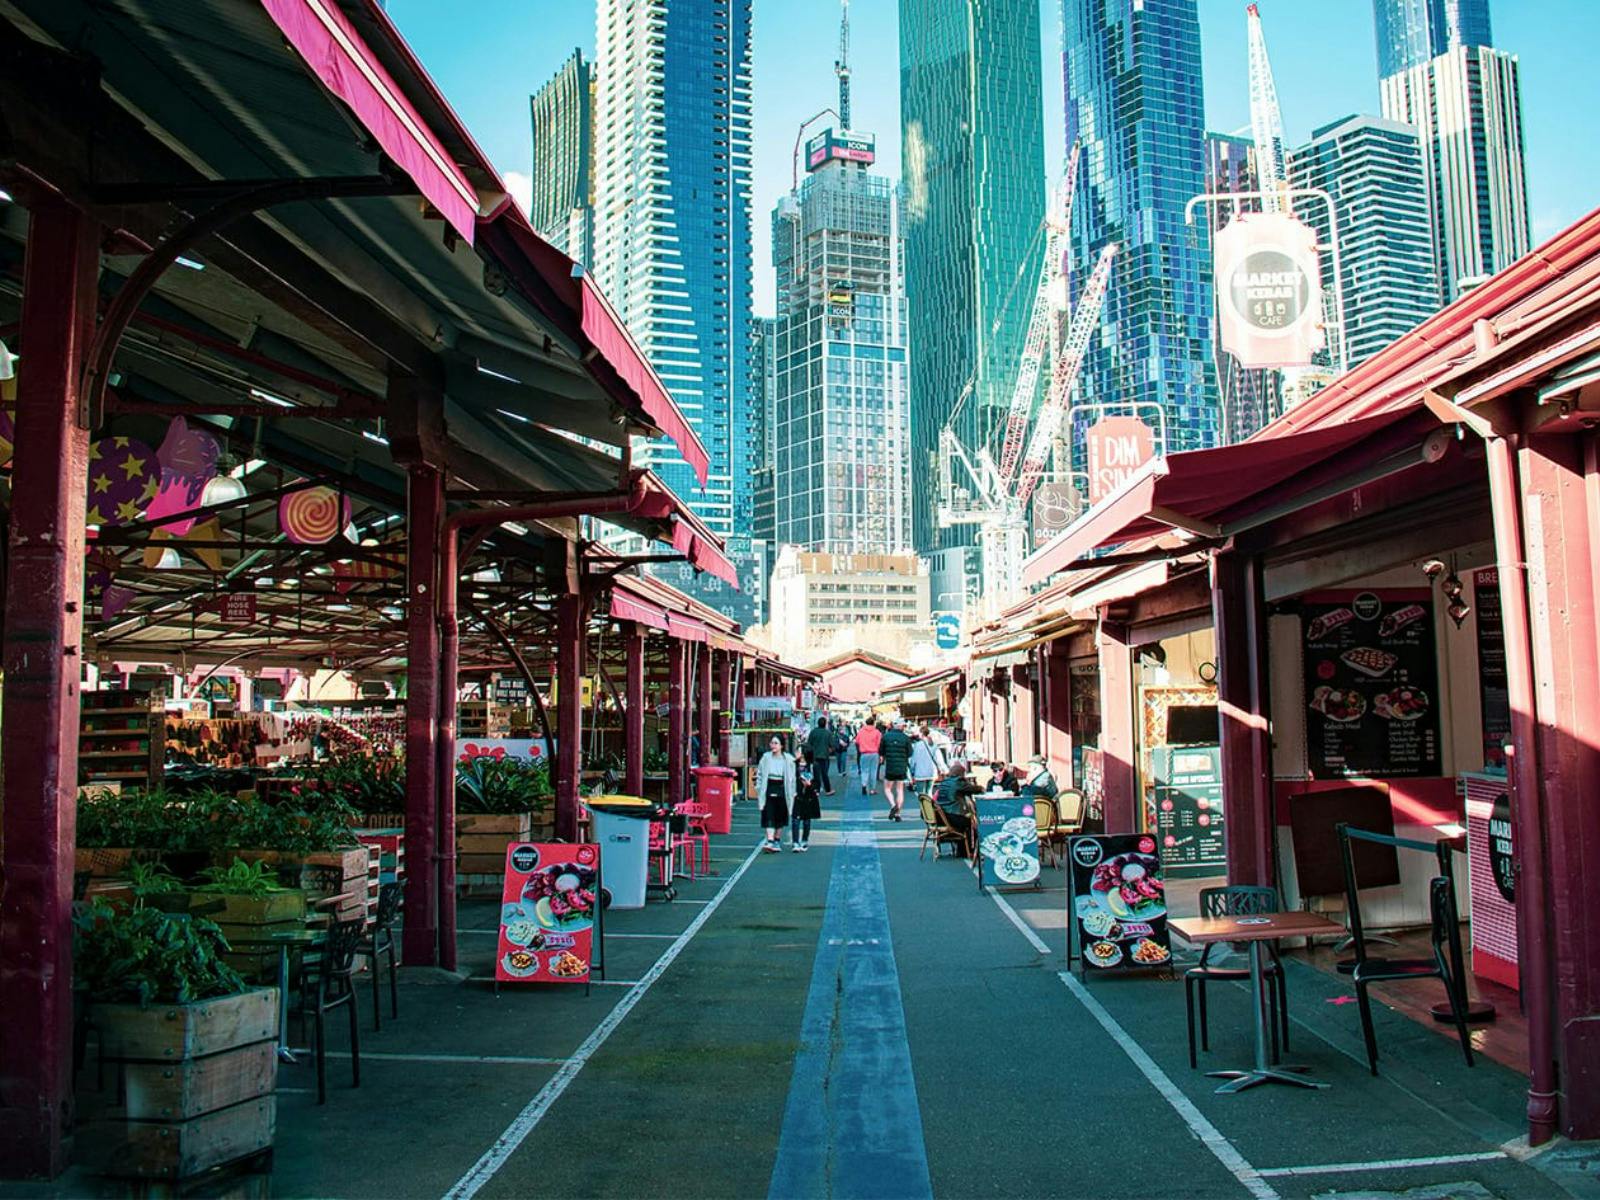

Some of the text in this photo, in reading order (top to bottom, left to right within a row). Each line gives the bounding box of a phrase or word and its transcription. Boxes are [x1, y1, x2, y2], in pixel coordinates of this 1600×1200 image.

[848, 141, 867, 151] ICON
[1246, 286, 1293, 299] KEBAB
[1105, 436, 1140, 466] DIM
